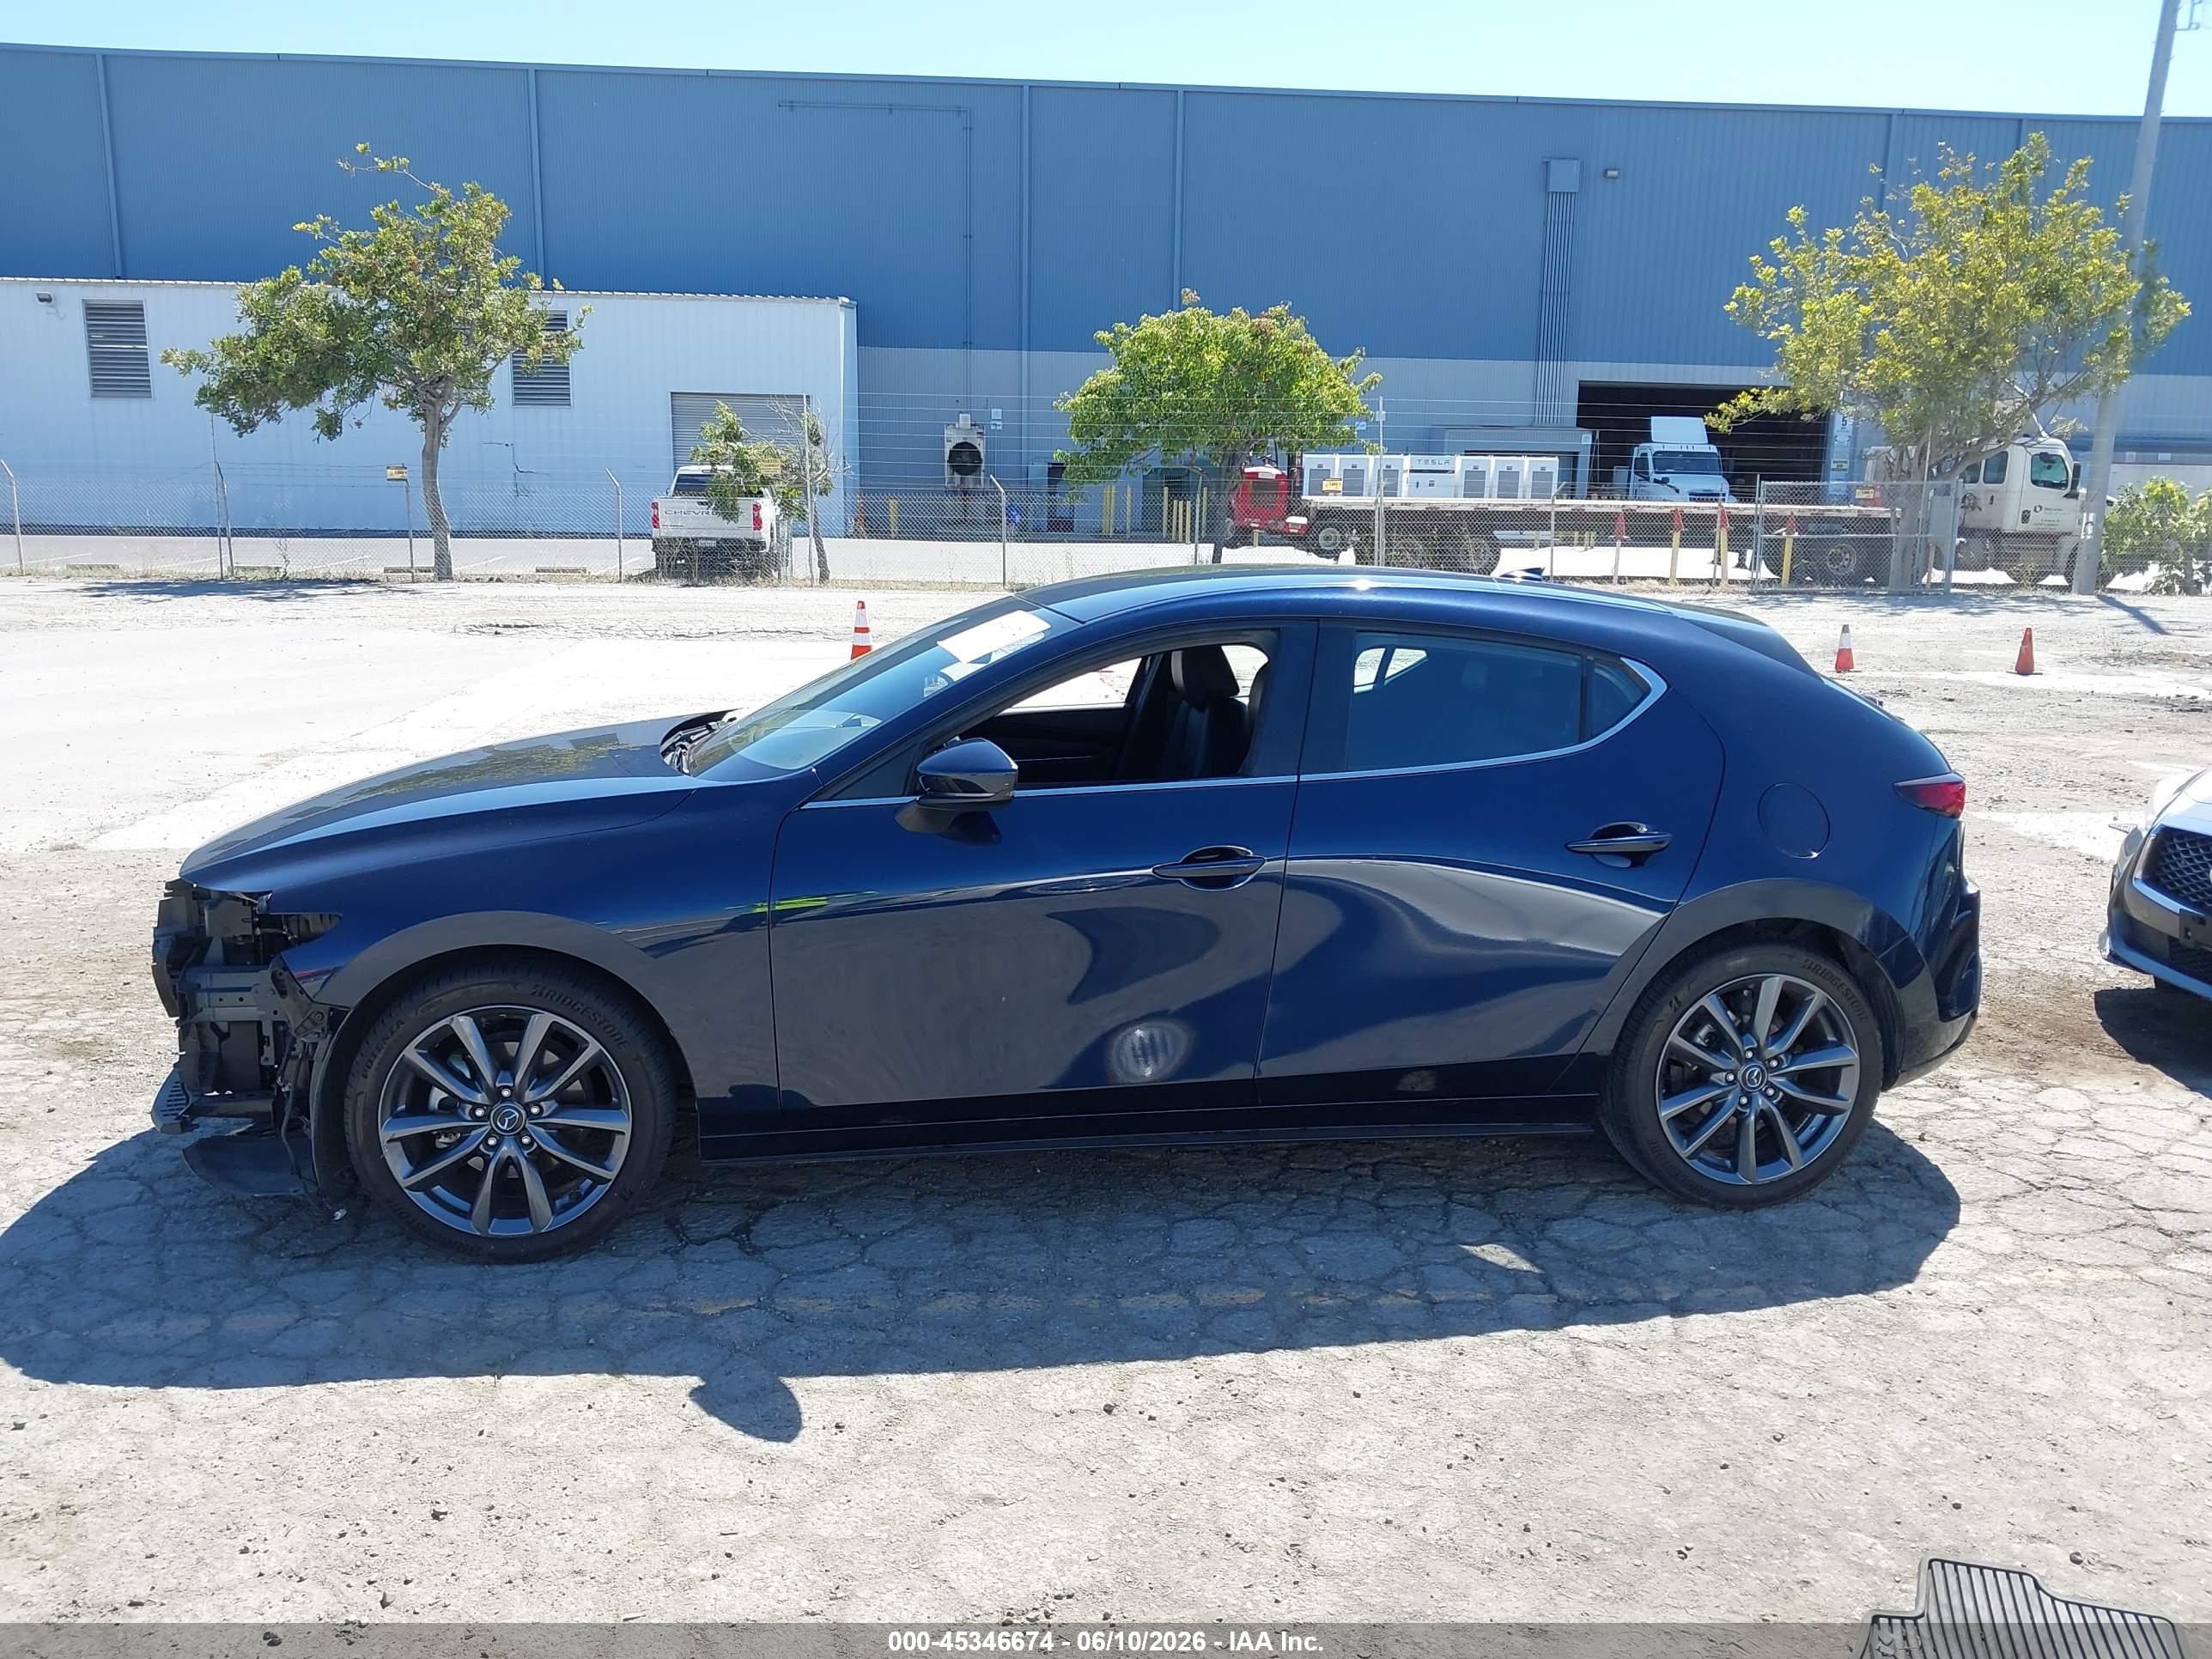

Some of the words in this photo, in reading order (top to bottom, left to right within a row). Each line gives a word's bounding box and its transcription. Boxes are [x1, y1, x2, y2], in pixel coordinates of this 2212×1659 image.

[530, 983, 631, 1048] BRIDGESTONE
[1800, 958, 1869, 1024] BRIDGESTONE
[361, 1019, 406, 1079] POTENZA
